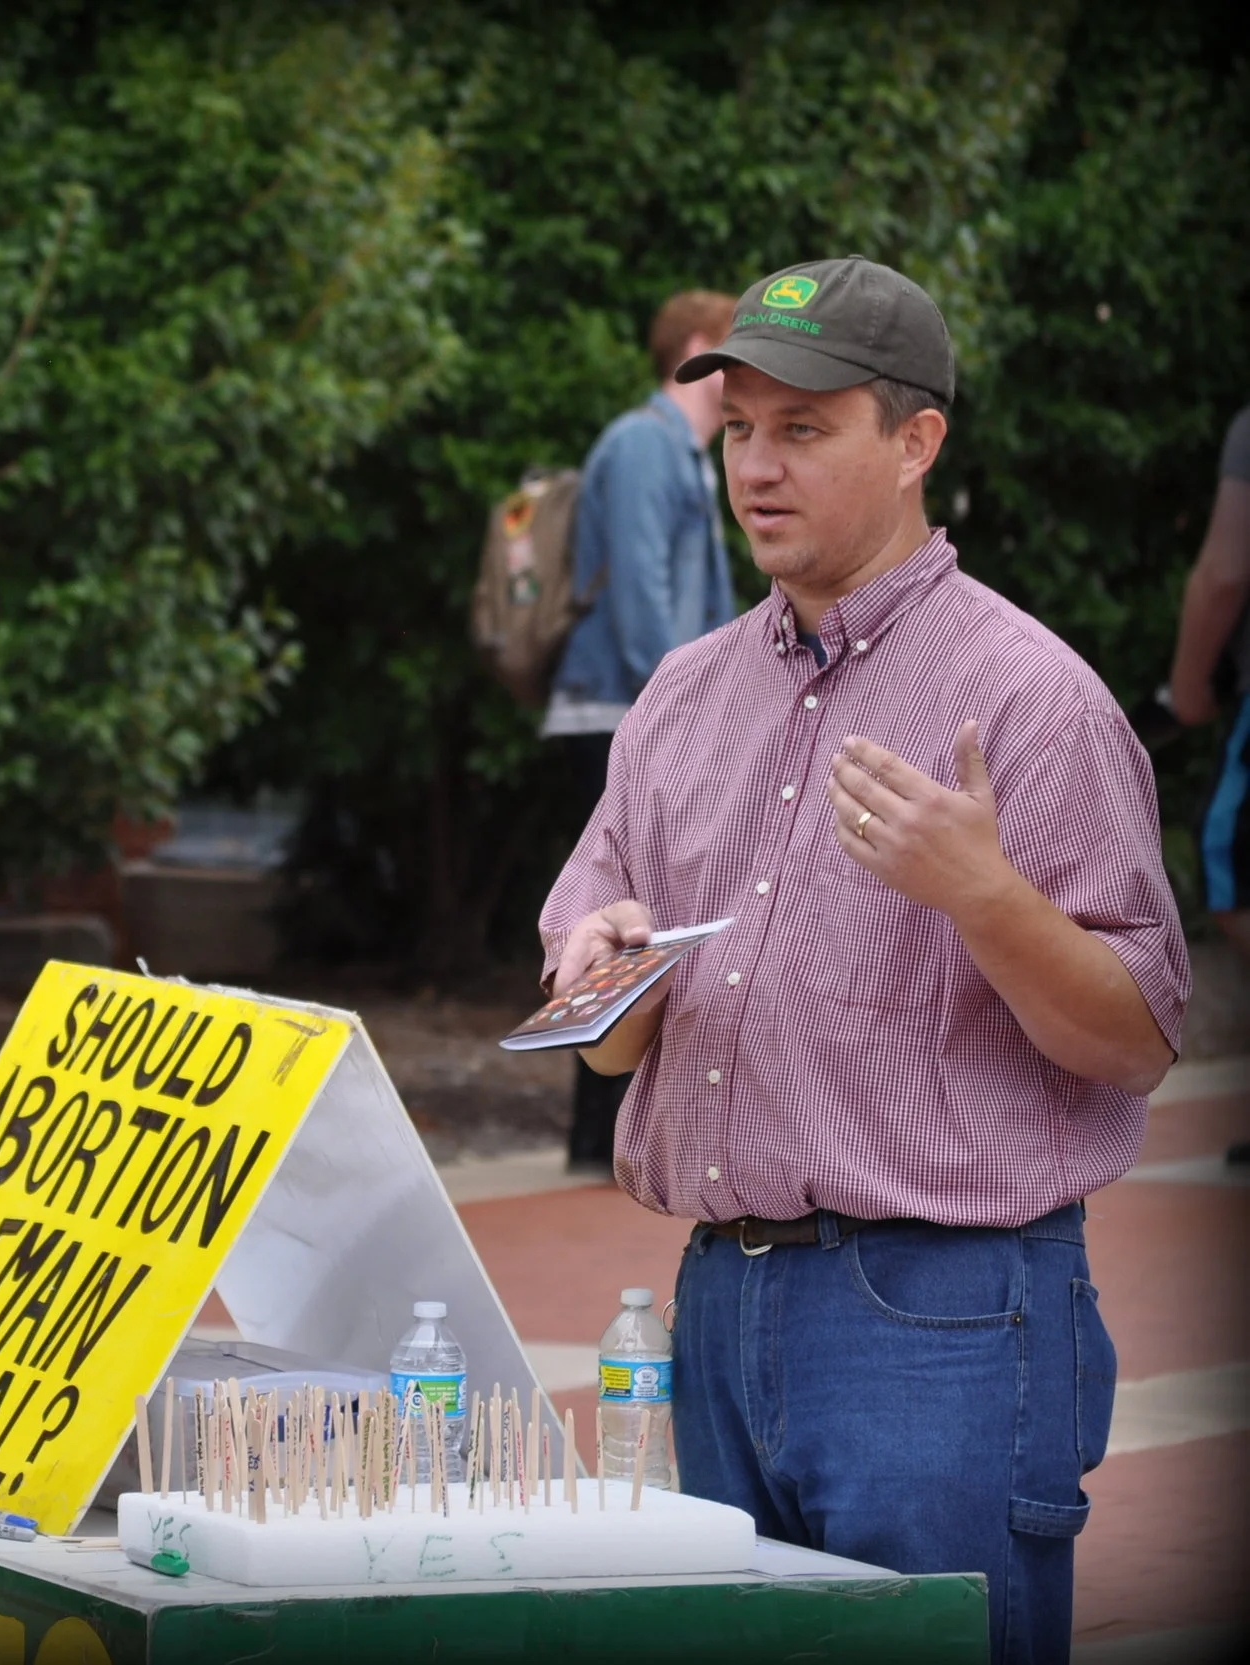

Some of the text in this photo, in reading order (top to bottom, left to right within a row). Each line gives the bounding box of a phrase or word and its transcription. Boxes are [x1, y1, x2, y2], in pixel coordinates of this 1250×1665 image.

[769, 312, 823, 335] DEERE
[47, 983, 253, 1107] SHOULD
[147, 1509, 191, 1561] YES
[363, 1531, 524, 1580] YES
